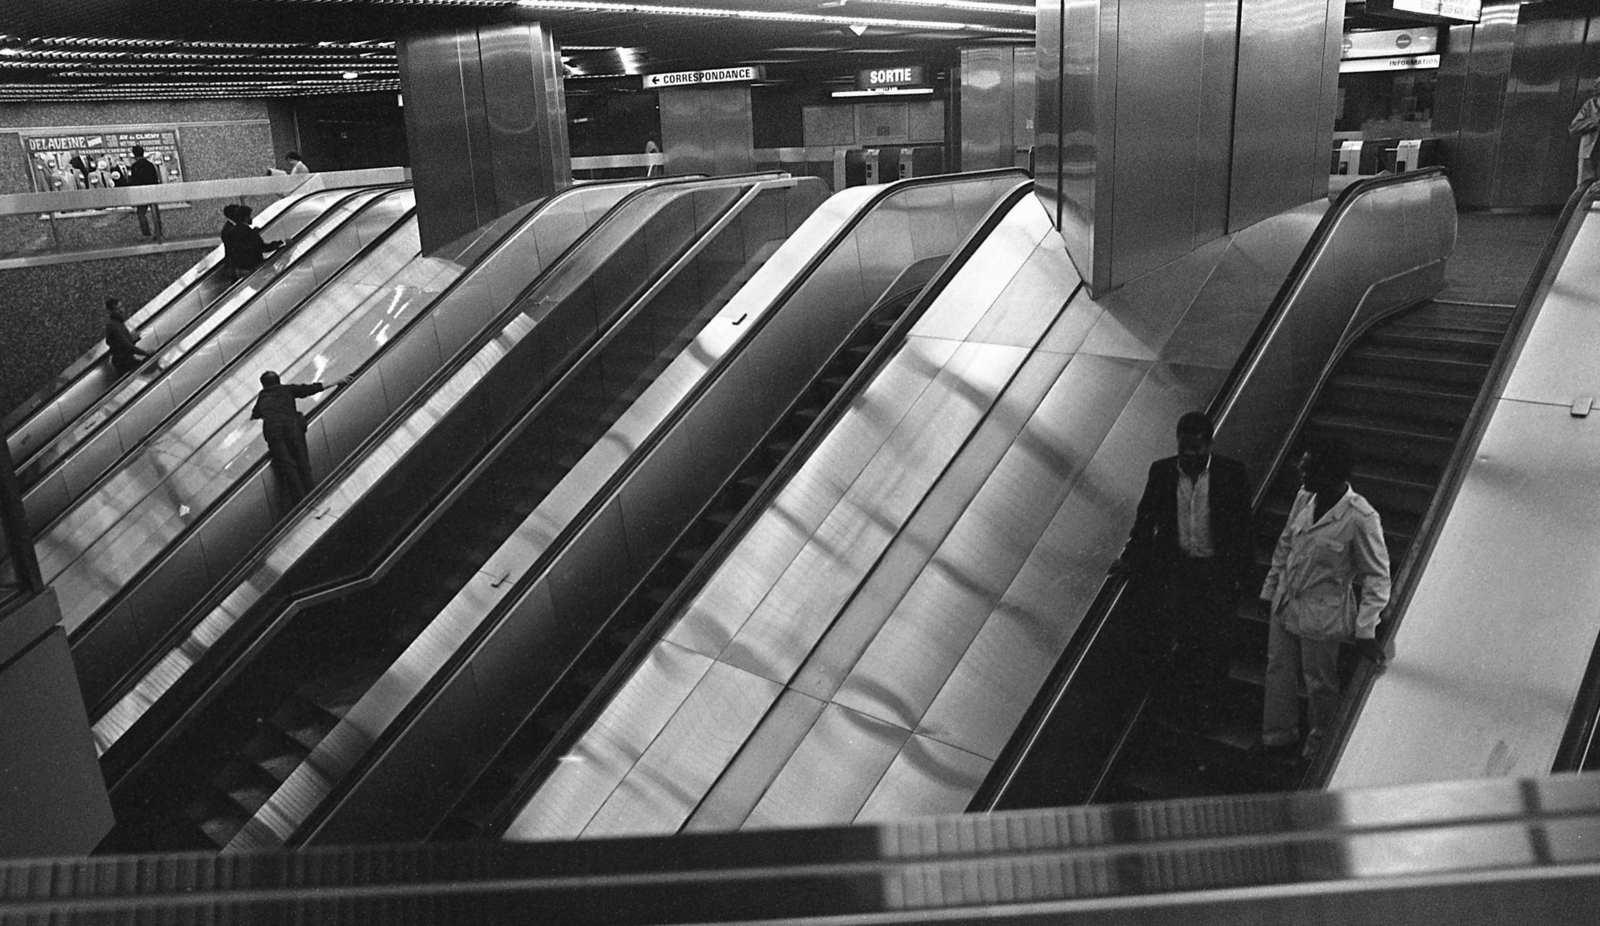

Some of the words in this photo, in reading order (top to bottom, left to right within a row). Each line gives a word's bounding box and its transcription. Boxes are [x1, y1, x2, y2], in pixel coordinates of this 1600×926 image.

[1389, 58, 1439, 67] INFORMATION
[663, 68, 751, 84] CORRESPONDANCE
[870, 68, 912, 84] SORTIE
